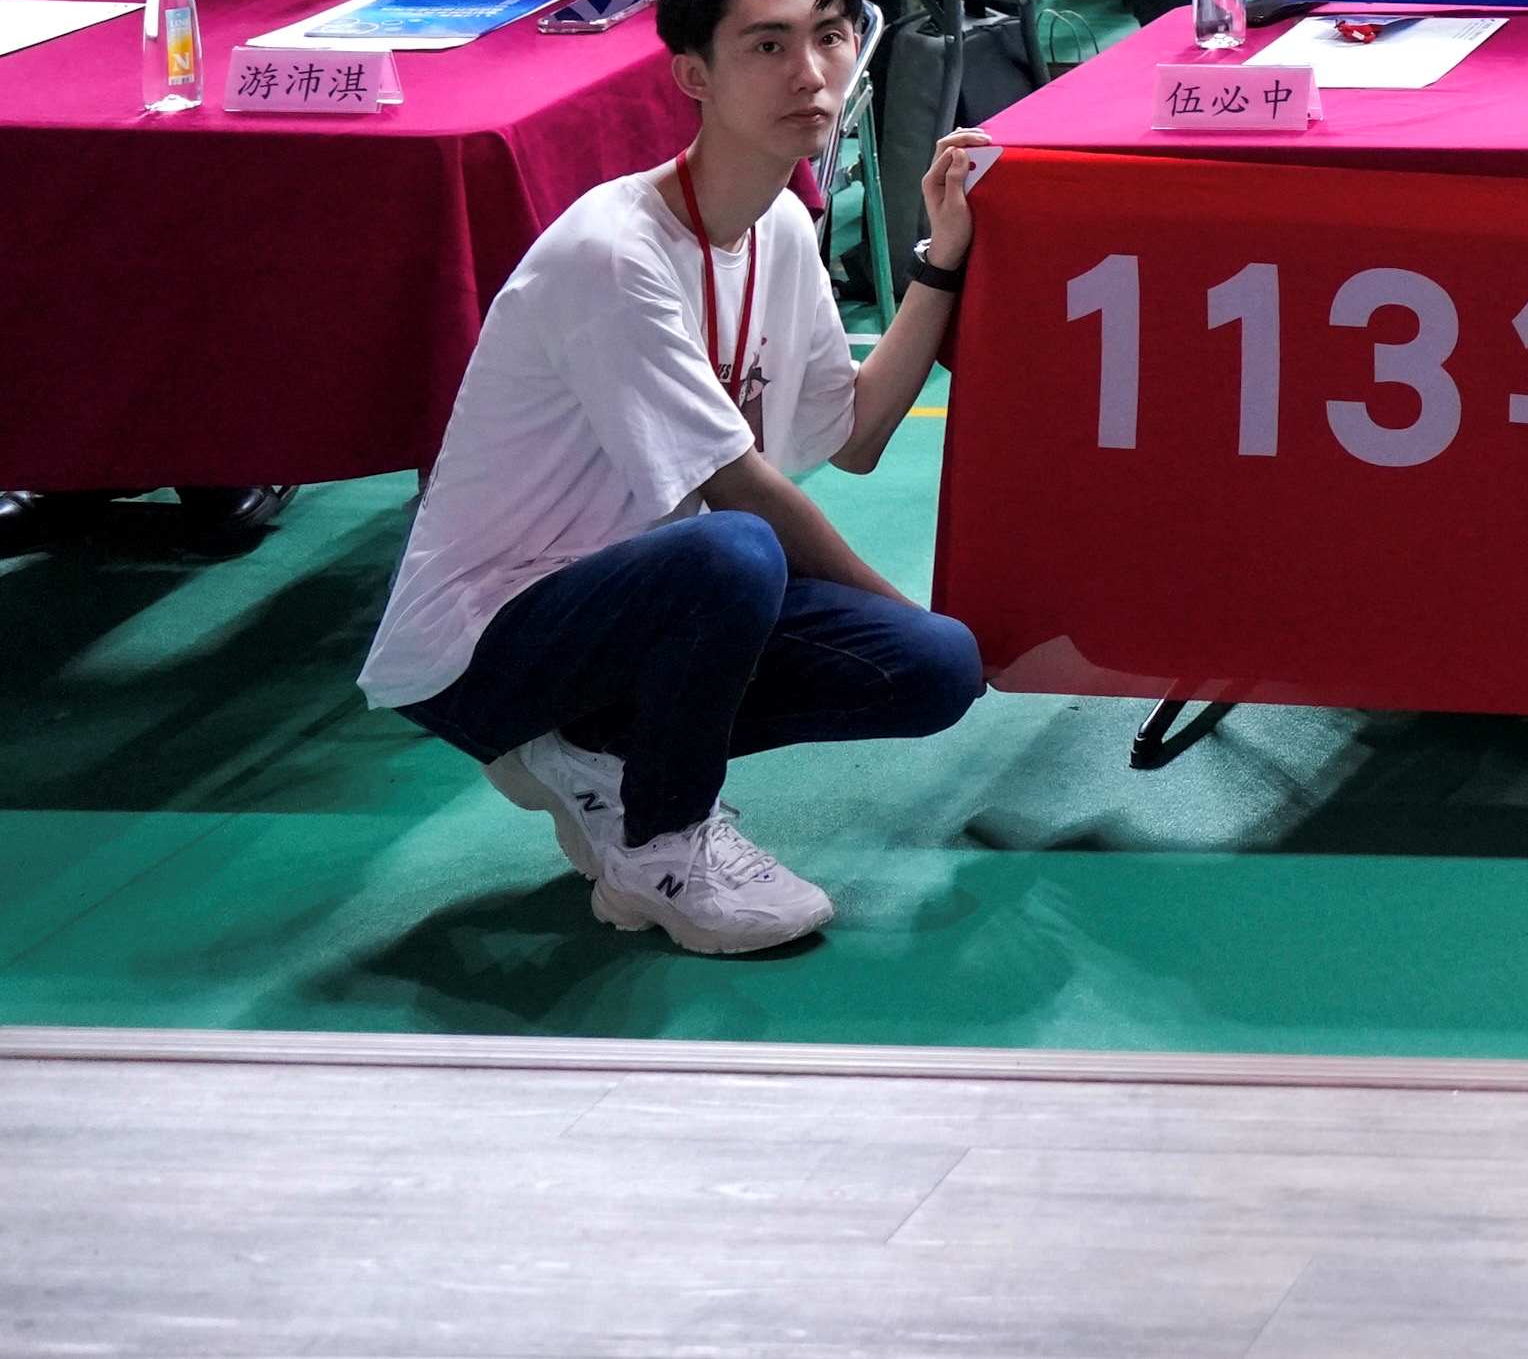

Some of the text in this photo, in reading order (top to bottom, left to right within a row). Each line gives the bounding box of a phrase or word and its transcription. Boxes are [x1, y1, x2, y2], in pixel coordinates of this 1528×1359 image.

[237, 62, 368, 103] 游沛淇
[1166, 78, 1295, 123] 伍必中
